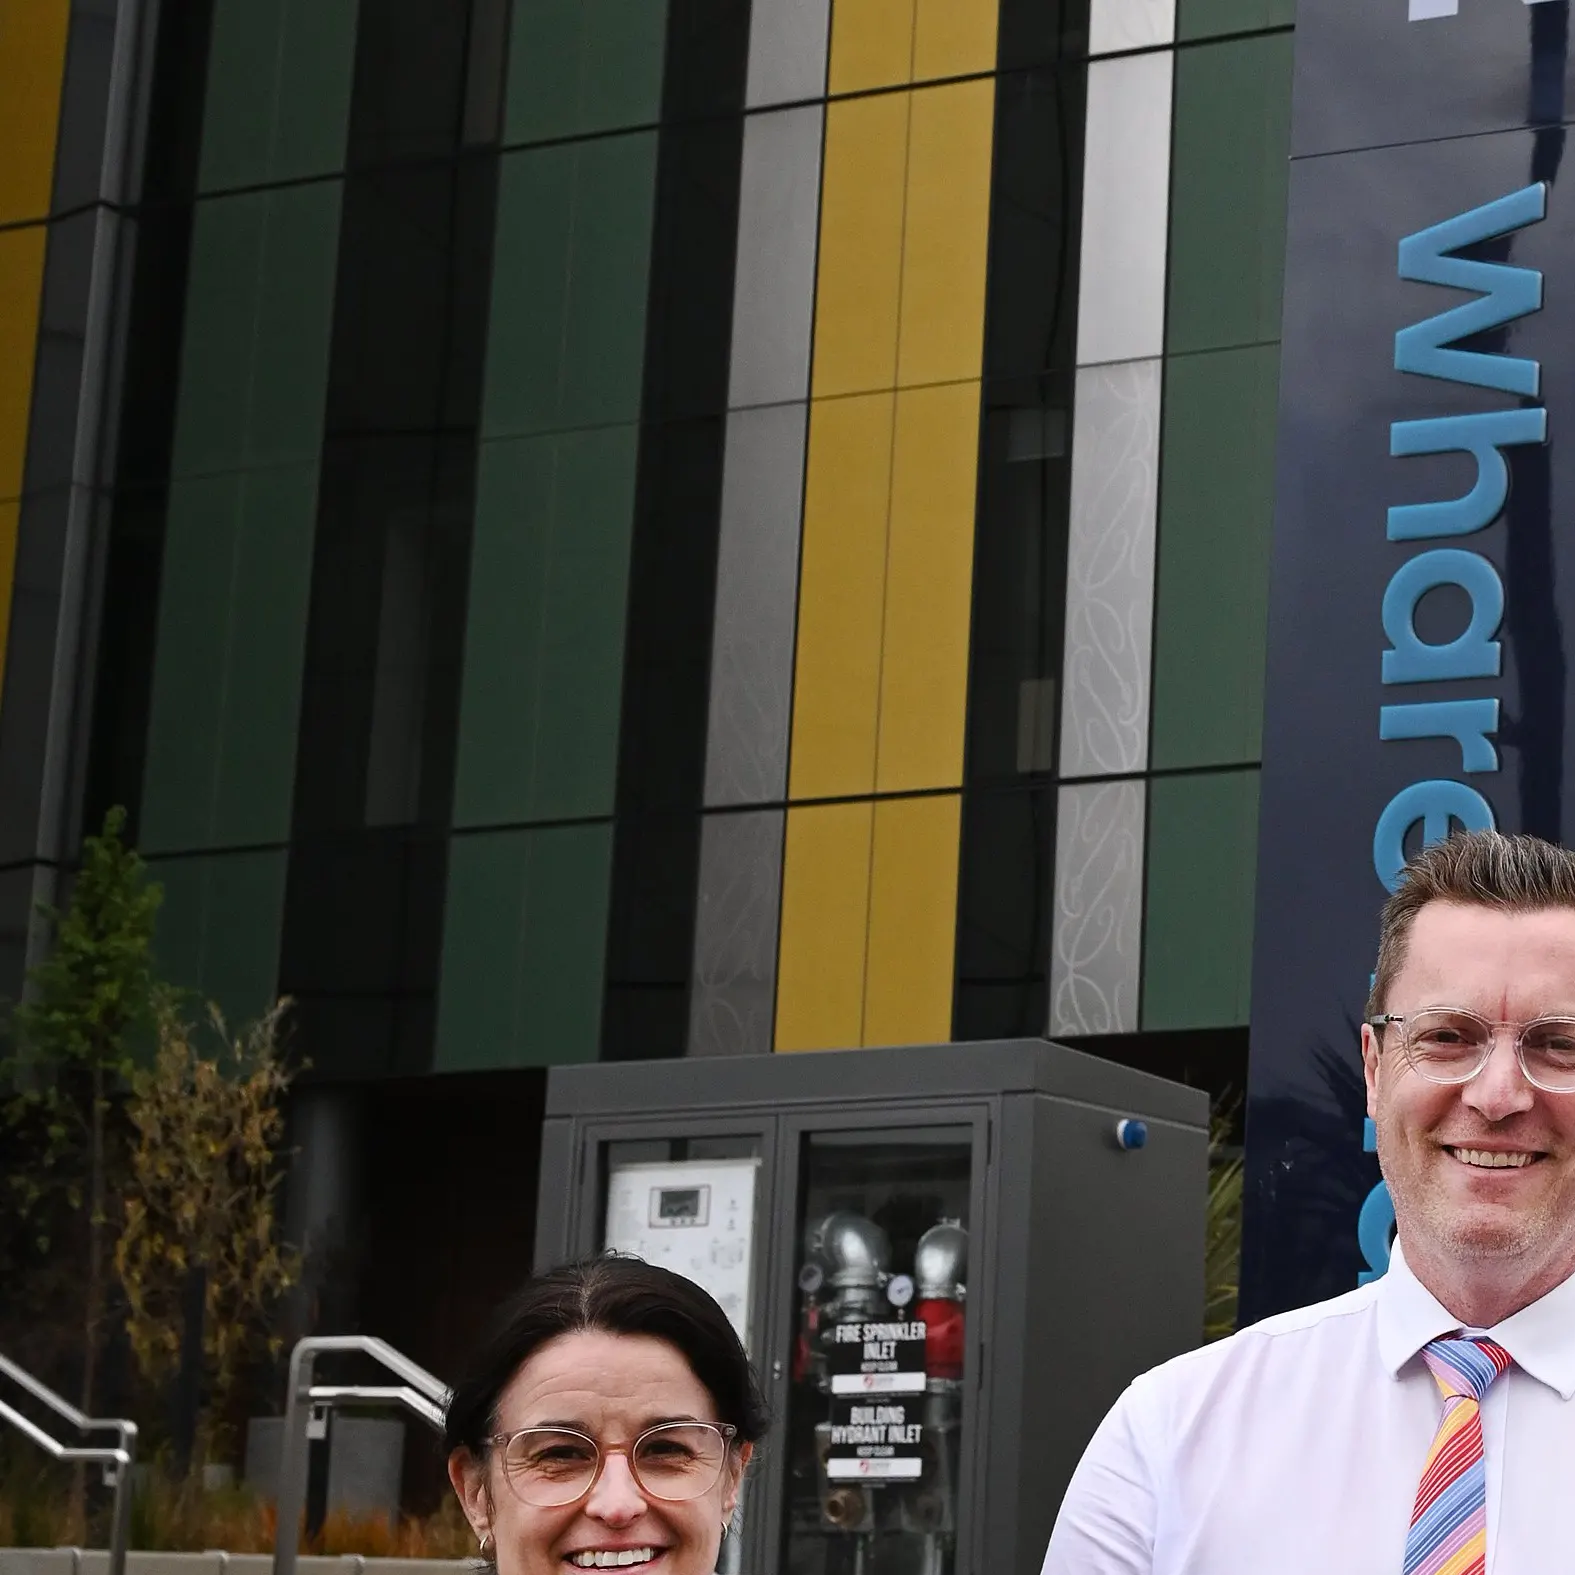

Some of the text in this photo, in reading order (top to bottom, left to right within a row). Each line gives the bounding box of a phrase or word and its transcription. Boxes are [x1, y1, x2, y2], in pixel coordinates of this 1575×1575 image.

[1373, 181, 1548, 896] Whare
[836, 1321, 926, 1343] FIRE SPRINKLER
[863, 1341, 897, 1360] INLET
[850, 1405, 905, 1425] BUILDING
[831, 1424, 923, 1444] HYDRANT INLET
